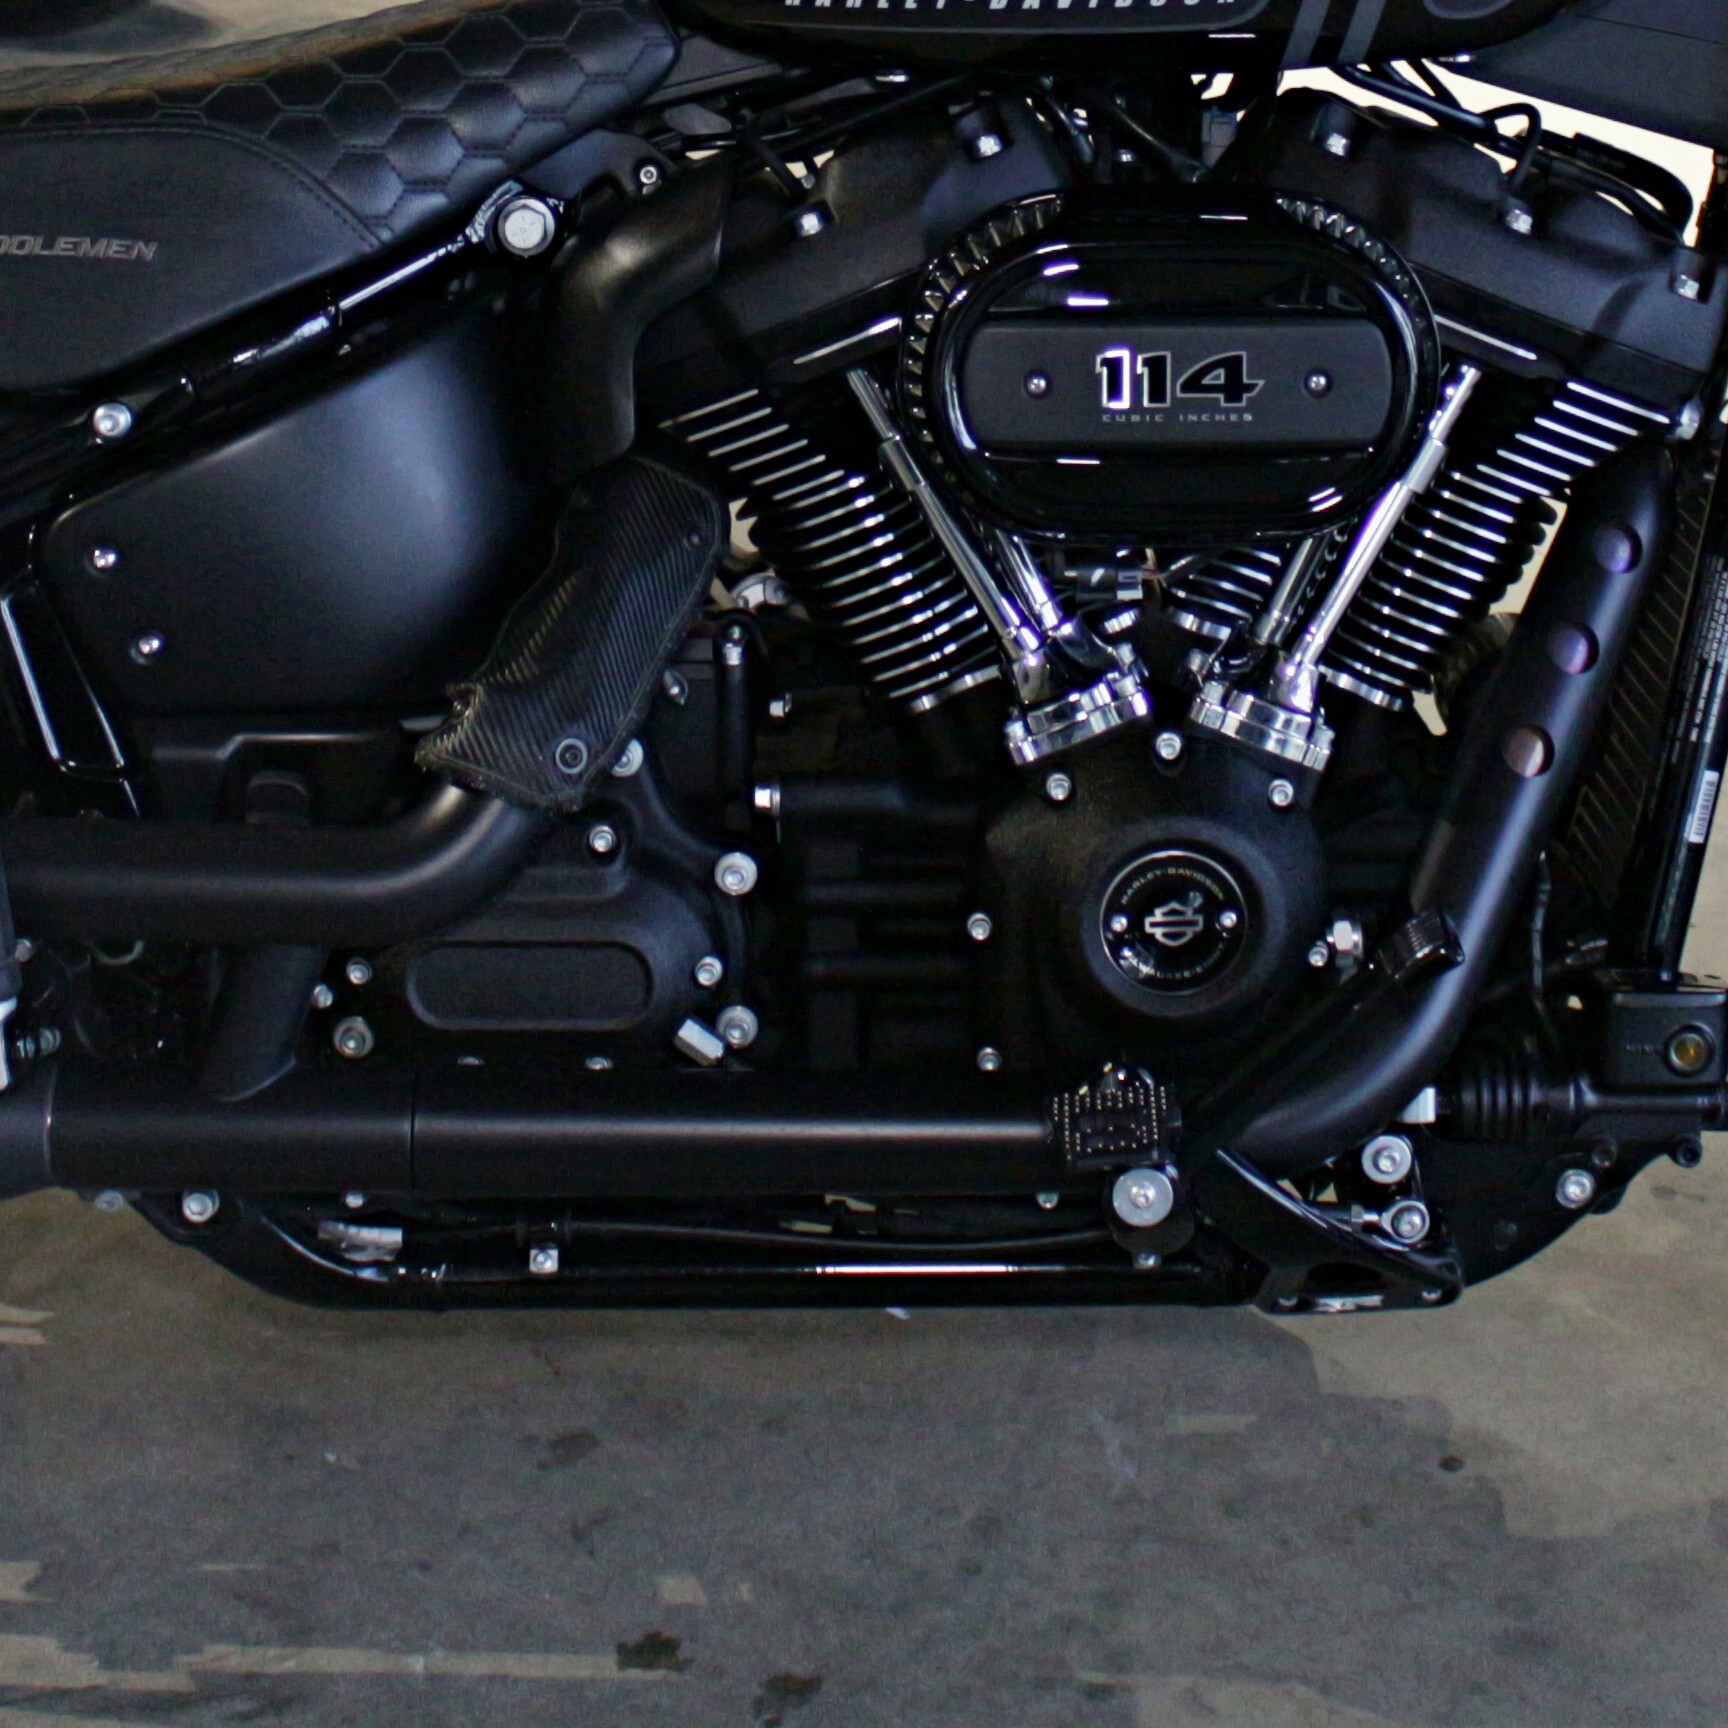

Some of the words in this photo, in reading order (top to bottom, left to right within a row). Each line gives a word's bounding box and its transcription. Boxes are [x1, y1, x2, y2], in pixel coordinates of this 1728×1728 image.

[1095, 349, 1265, 409] 114
[1102, 413, 1165, 423] CUBIC
[1178, 413, 1254, 423] INCHES
